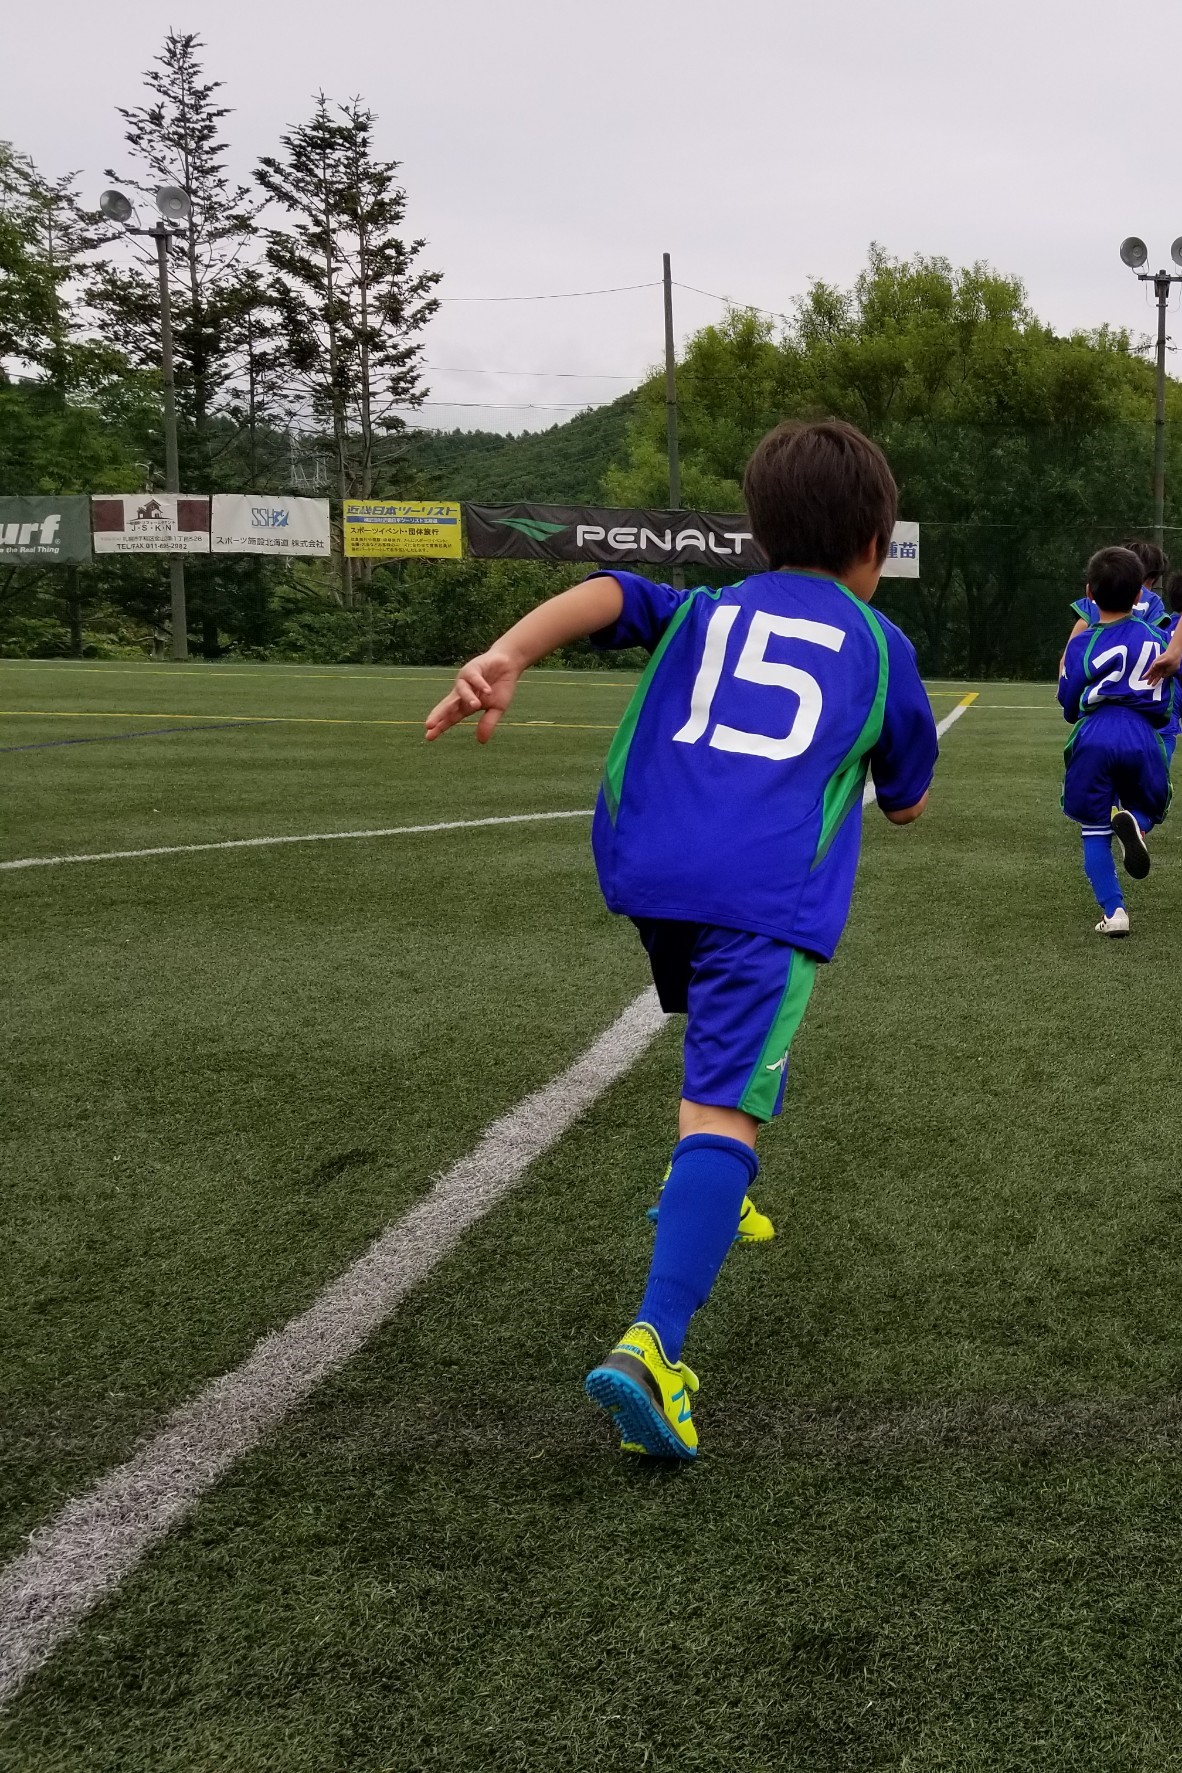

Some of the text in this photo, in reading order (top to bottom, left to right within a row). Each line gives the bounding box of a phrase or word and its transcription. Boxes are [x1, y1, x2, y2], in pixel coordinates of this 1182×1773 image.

[347, 505, 458, 515] 近畿日本ツーリスト
[291, 539, 325, 548] 株式会社
[37, 546, 60, 554] Thing
[1087, 641, 1163, 705] 24
[672, 605, 846, 761] 15
